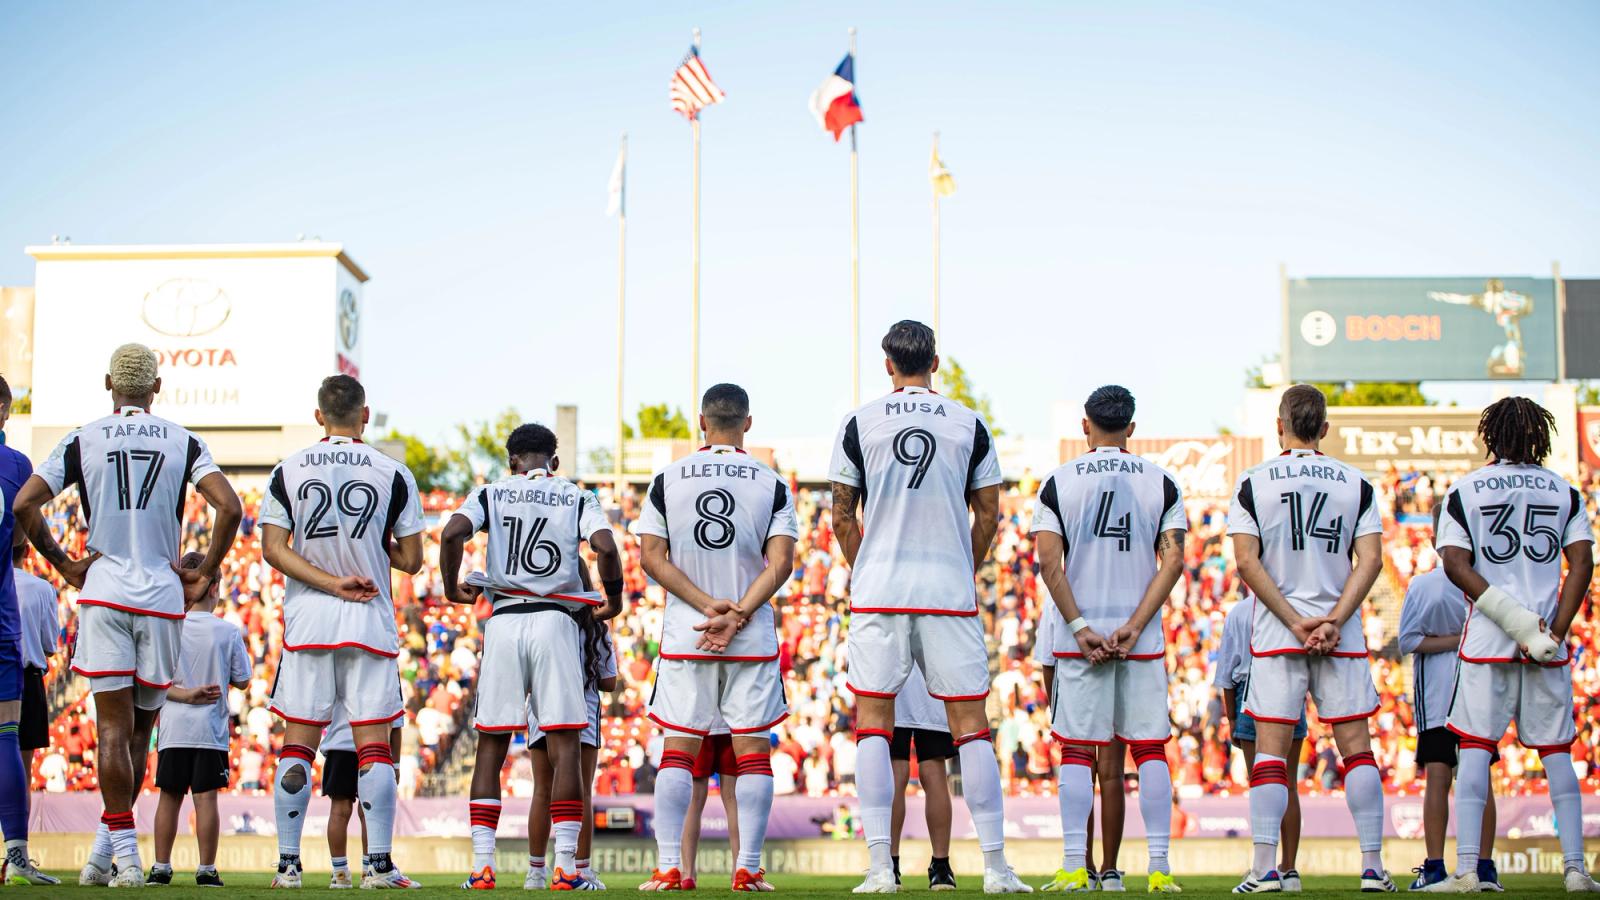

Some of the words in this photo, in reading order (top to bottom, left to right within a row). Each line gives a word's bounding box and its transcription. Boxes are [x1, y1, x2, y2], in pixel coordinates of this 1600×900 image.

[1345, 314, 1441, 341] BOSCH
[152, 348, 238, 367] OYOTA
[156, 387, 240, 405] ADIUM
[885, 402, 947, 417] MUSA
[102, 423, 168, 439] TAFARI
[299, 451, 373, 468] JUNQUA
[892, 426, 937, 490] 9
[1075, 458, 1144, 475] FARFAN
[106, 449, 166, 511] 17
[680, 463, 760, 480] LLETGET
[1269, 464, 1348, 484] ILLARRA
[1473, 474, 1560, 494] PONDECA
[297, 478, 379, 540] 29
[693, 487, 736, 552] 8
[1093, 490, 1131, 552] 4
[1280, 491, 1343, 555] 14
[1479, 503, 1561, 565] 35
[502, 515, 562, 578] 16
[591, 847, 660, 873] FFICIA
[1526, 847, 1599, 874] TURY
